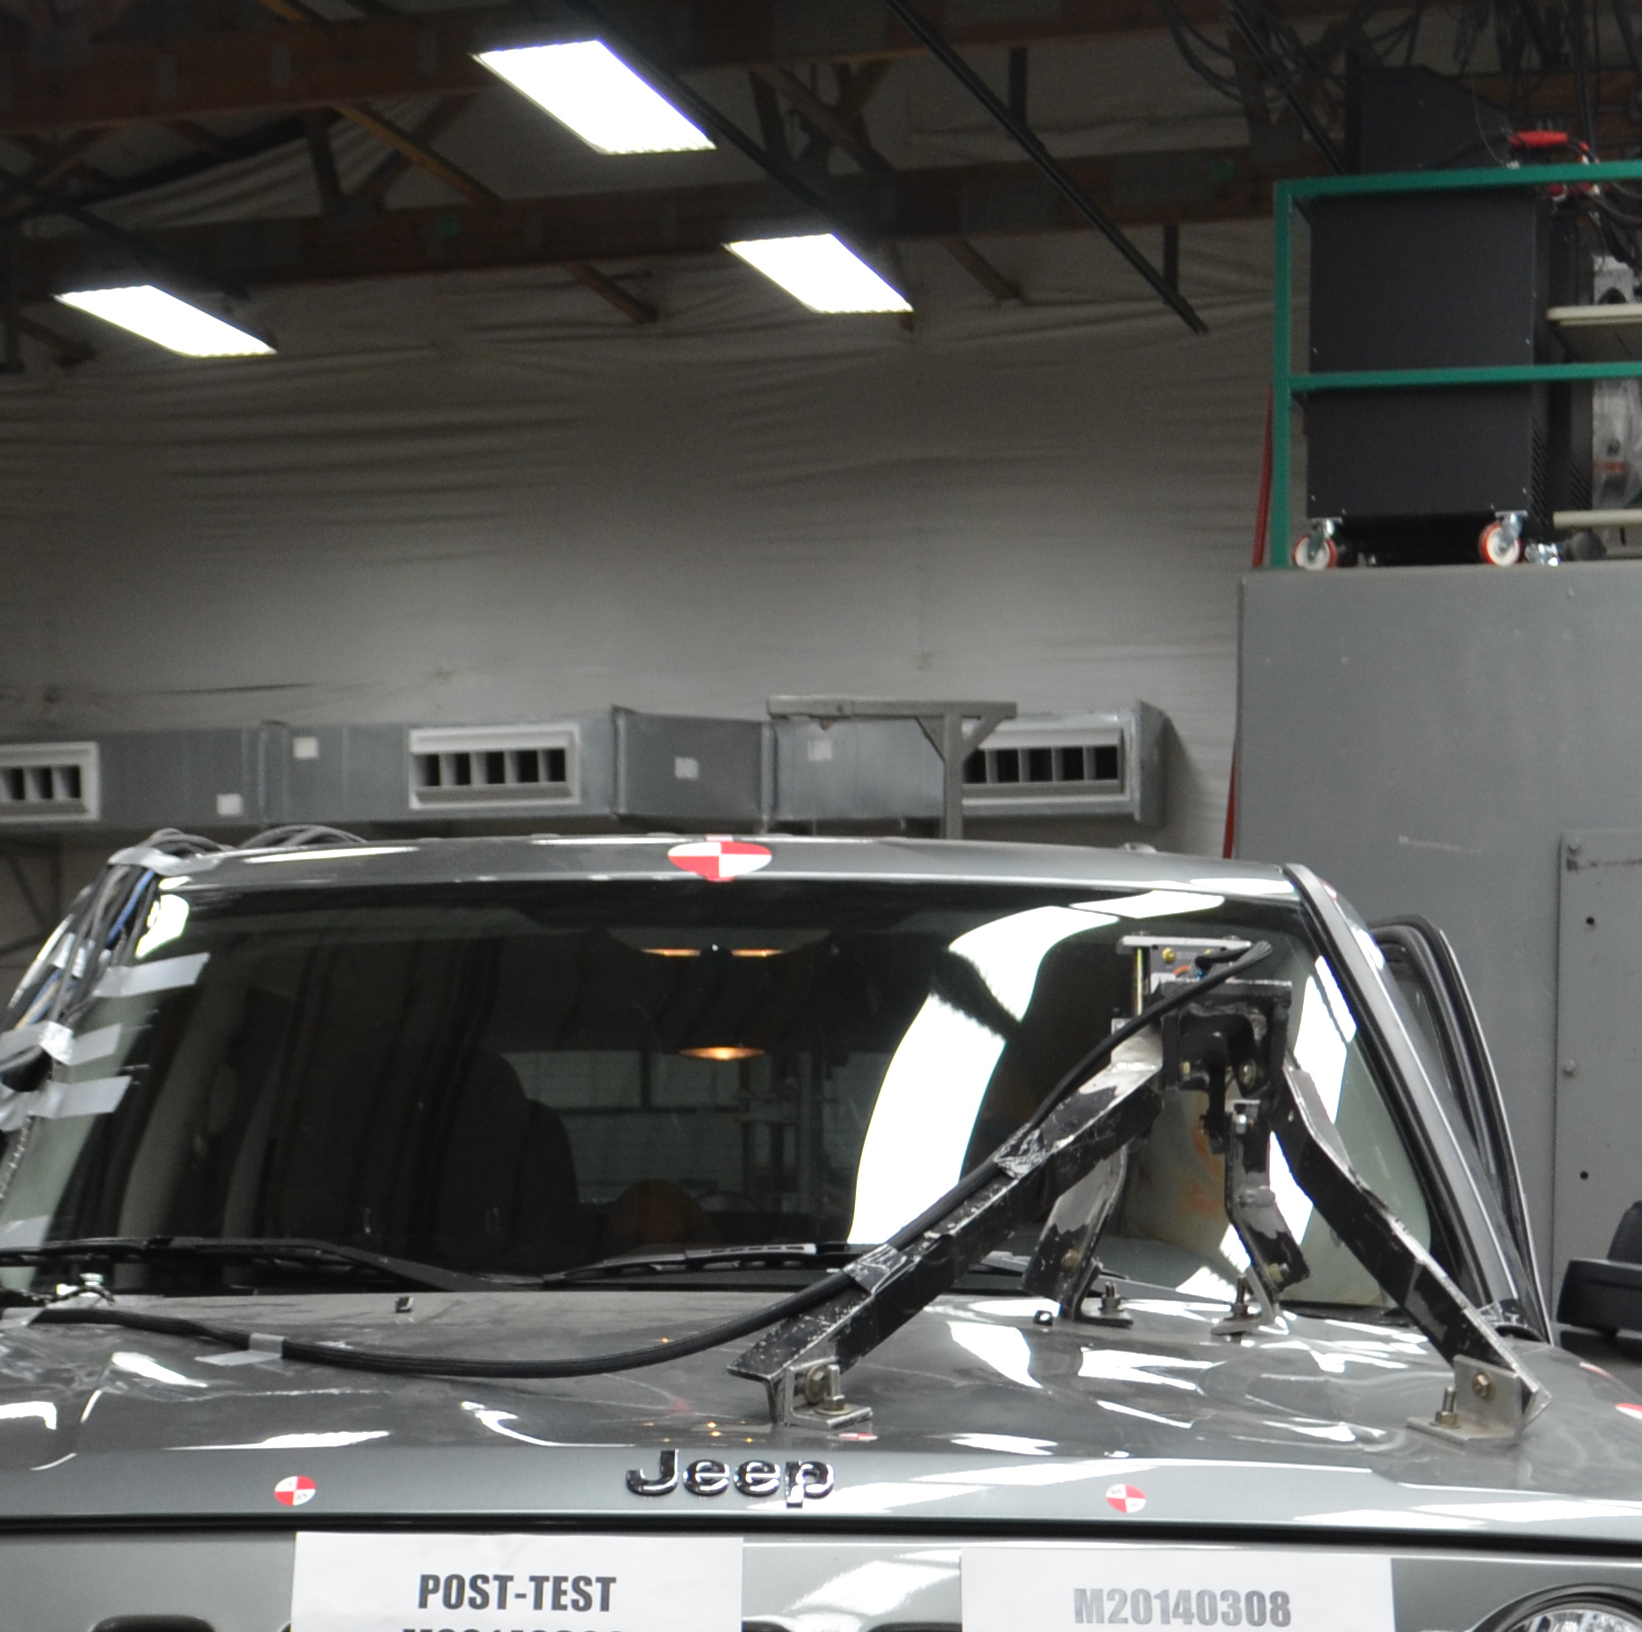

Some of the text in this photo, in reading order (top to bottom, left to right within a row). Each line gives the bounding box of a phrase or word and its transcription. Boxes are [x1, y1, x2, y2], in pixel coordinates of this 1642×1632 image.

[624, 1448, 835, 1509] Jeep
[418, 1573, 617, 1613] POST-TEST
[1073, 1588, 1292, 1628] M20140308
